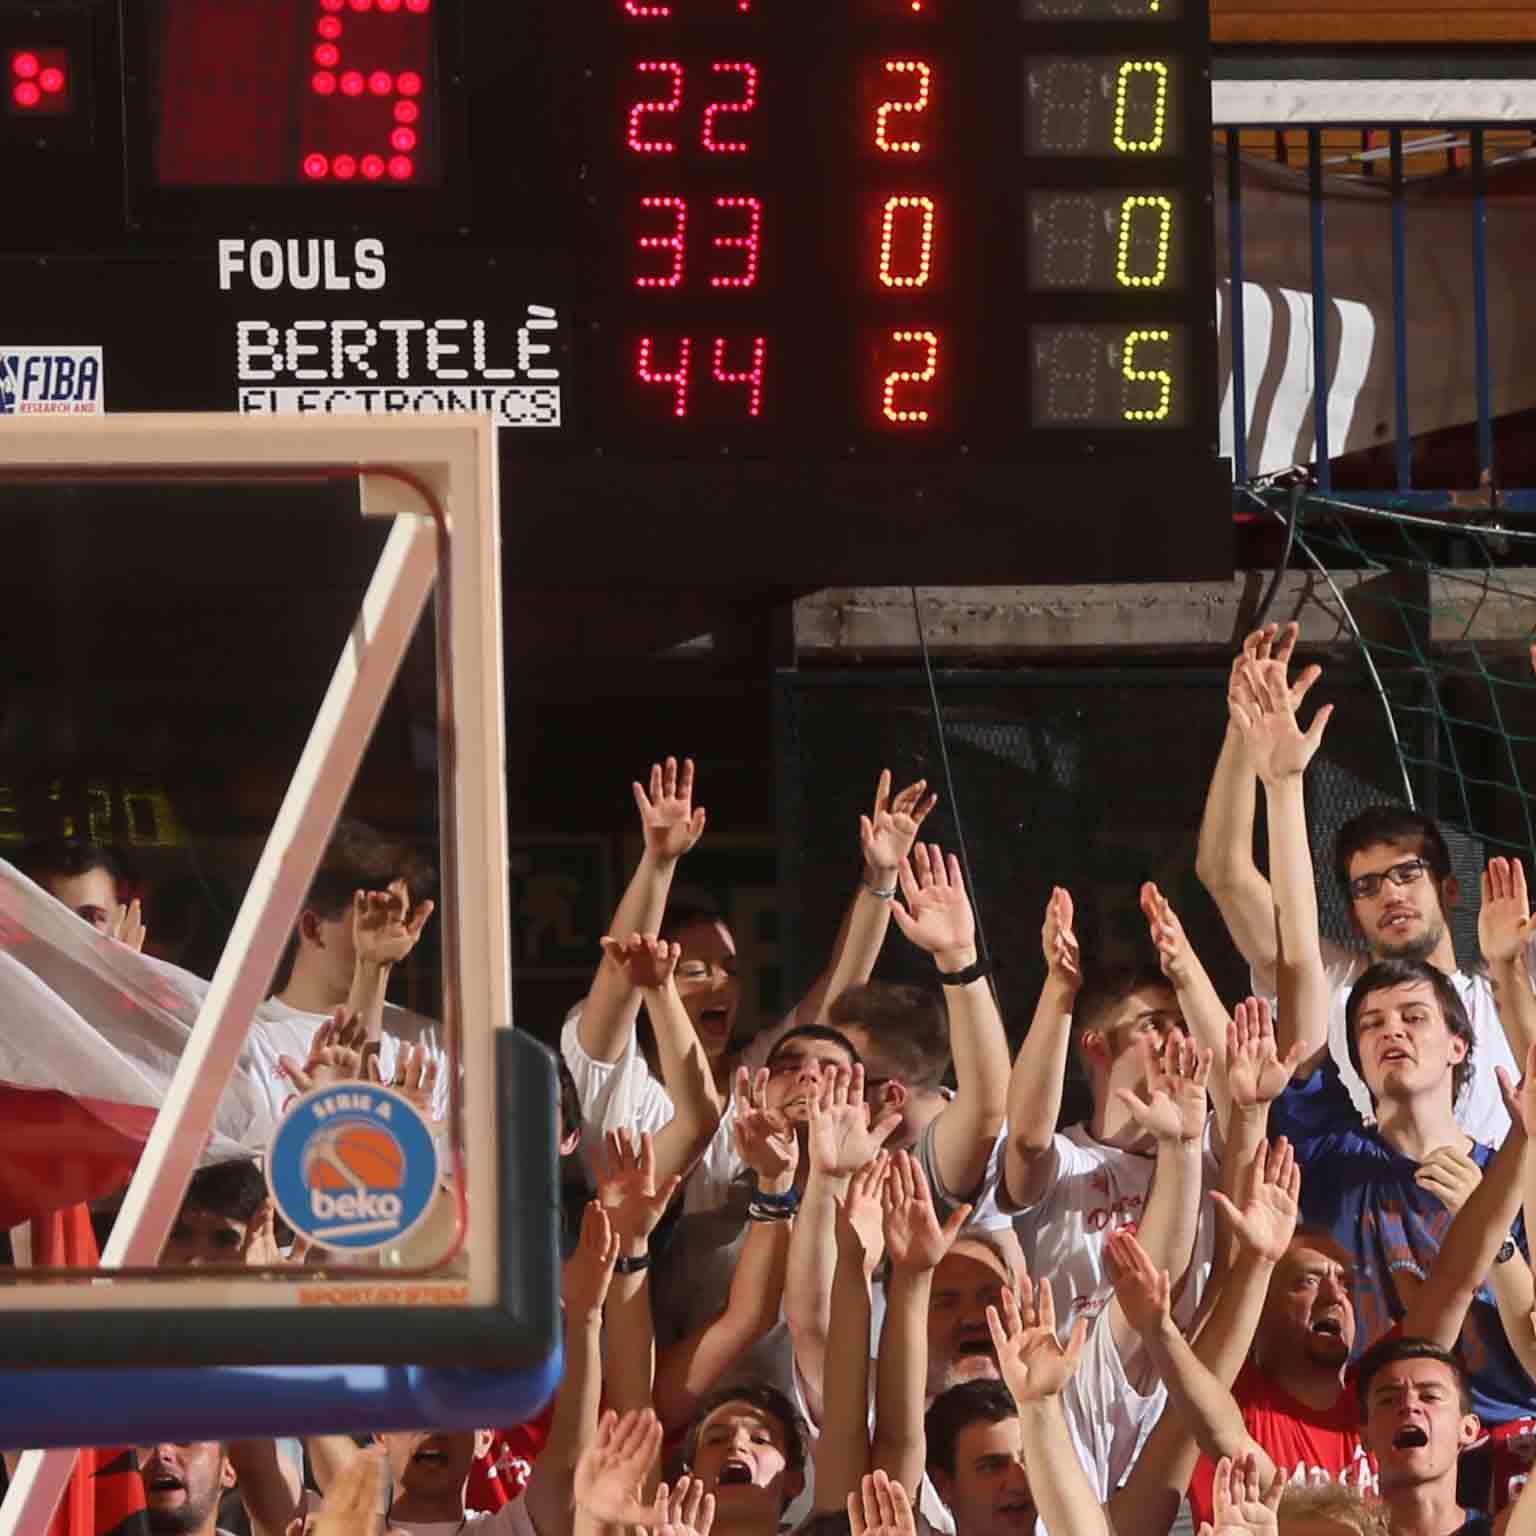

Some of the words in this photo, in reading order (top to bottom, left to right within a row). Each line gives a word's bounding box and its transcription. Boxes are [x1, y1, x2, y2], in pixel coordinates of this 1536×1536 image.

[305, 0, 430, 179] 5
[627, 61, 758, 152] 22
[876, 61, 930, 152] 2
[1114, 61, 1168, 152] 0
[218, 239, 387, 290] FOULS
[634, 196, 762, 287] 33
[879, 196, 934, 288] 0
[1115, 196, 1172, 288] 0
[22, 357, 99, 401] FIBA
[638, 336, 766, 418] 44
[882, 331, 938, 422] 2
[1121, 330, 1173, 422] 5
[312, 1187, 403, 1220] beko
